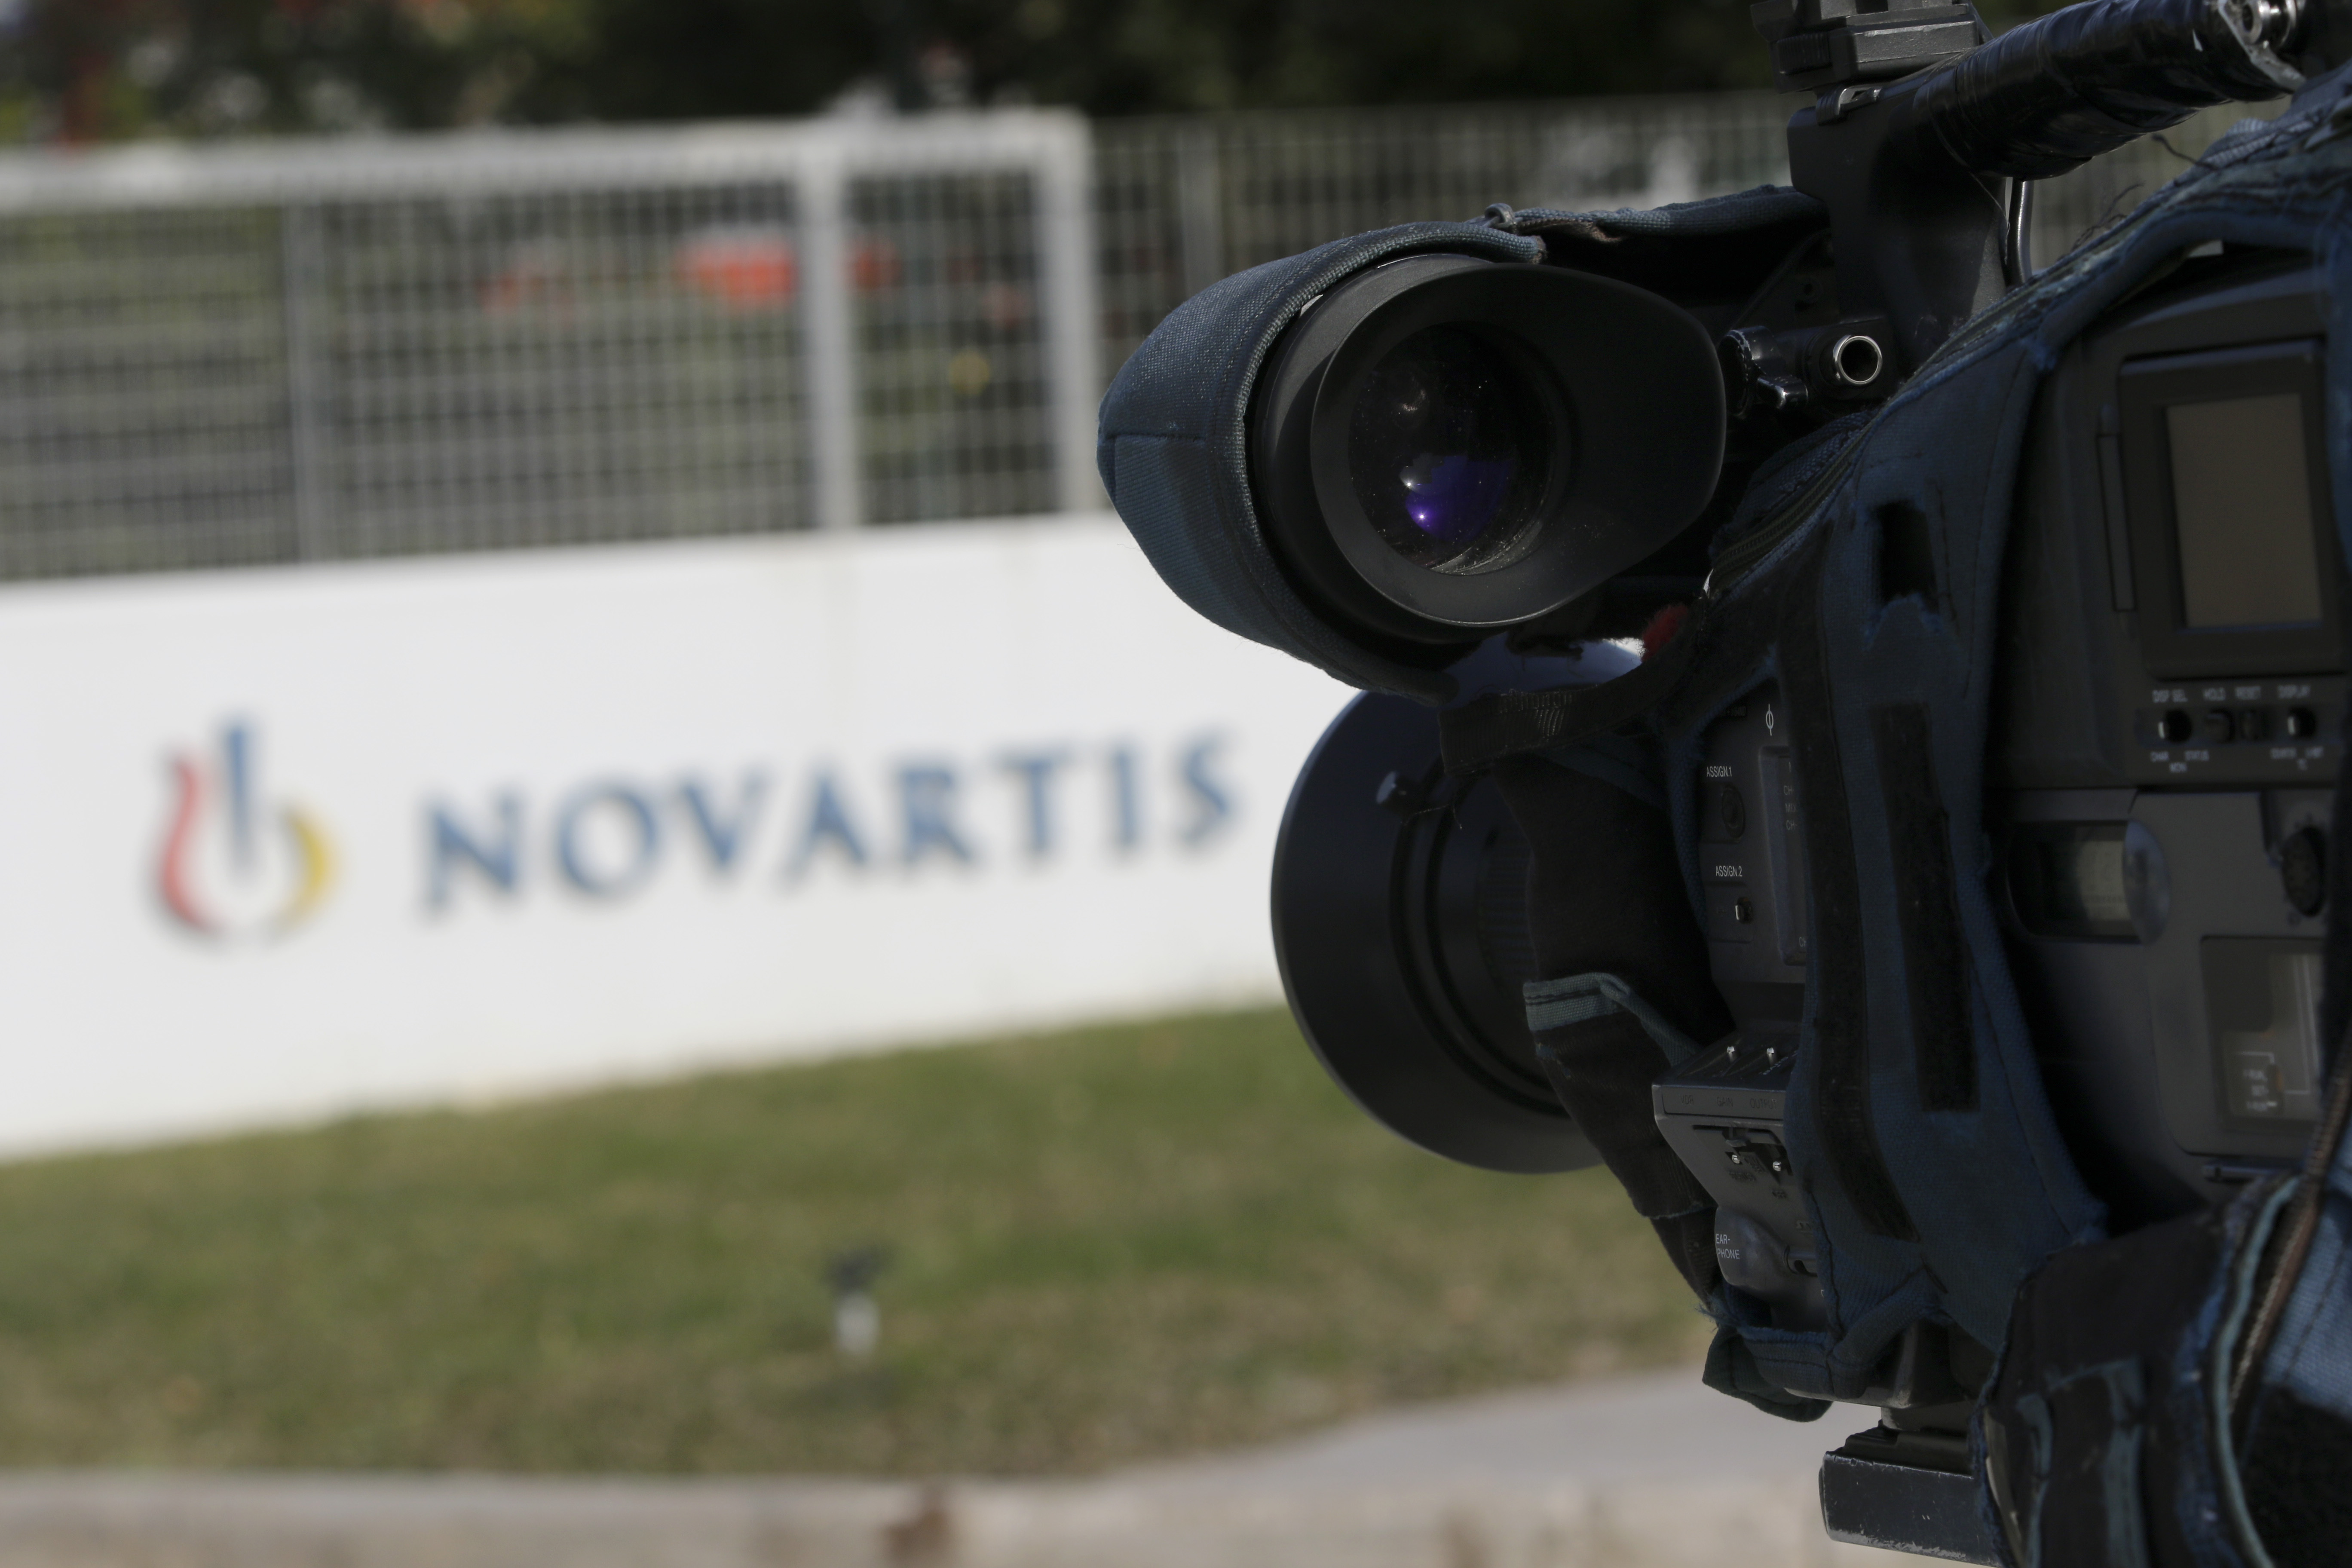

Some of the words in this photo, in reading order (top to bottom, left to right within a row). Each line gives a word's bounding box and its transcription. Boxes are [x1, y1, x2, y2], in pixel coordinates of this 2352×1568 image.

[1706, 766, 1732, 777] ASSIGN.1
[419, 729, 1244, 920] NOVARTIS
[1715, 865, 1743, 877] ASSIGN.2
[1717, 1096, 1733, 1107] GAIN
[1750, 1098, 1777, 1110] OUTPUT
